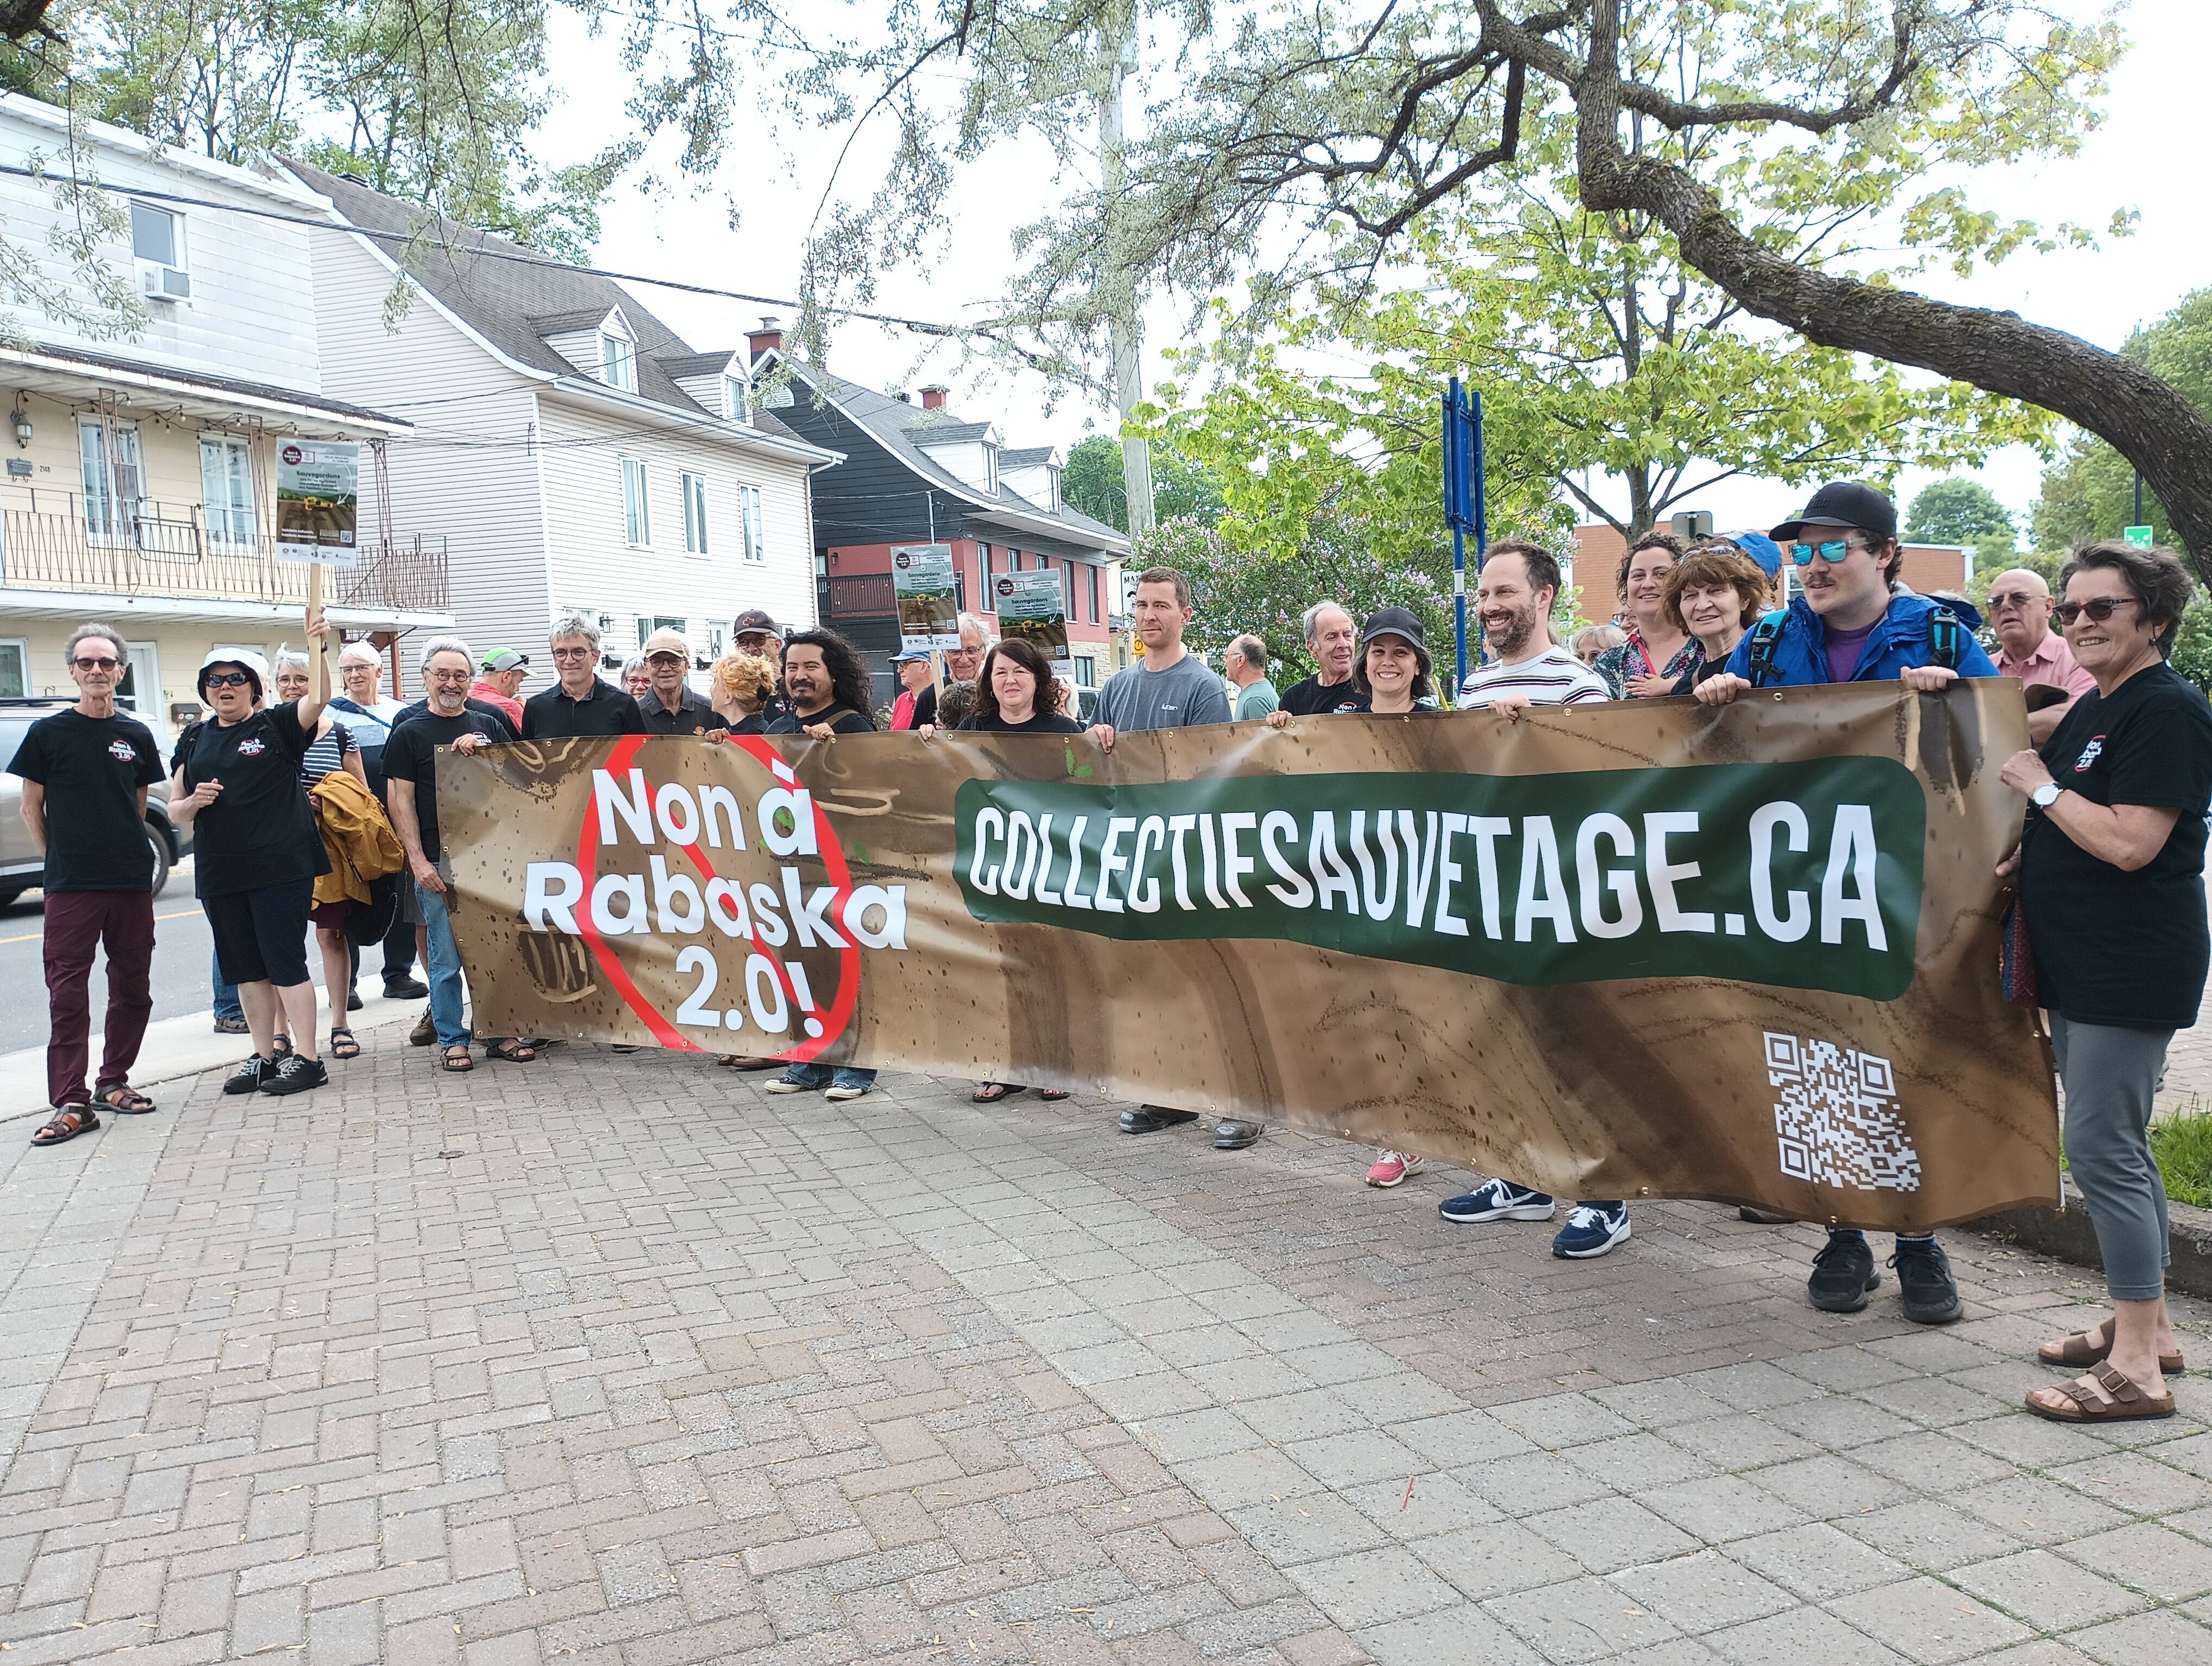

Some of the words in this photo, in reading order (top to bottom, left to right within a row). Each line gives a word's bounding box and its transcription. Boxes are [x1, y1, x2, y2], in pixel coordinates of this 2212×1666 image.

[297, 471, 340, 479] Sauvegardons
[593, 767, 747, 851] Non
[757, 758, 818, 856] à
[523, 855, 909, 950] Rabaska
[969, 800, 1888, 952] COLLECTIFSAUVETAGE.CA
[676, 945, 824, 1037] 2.0!
